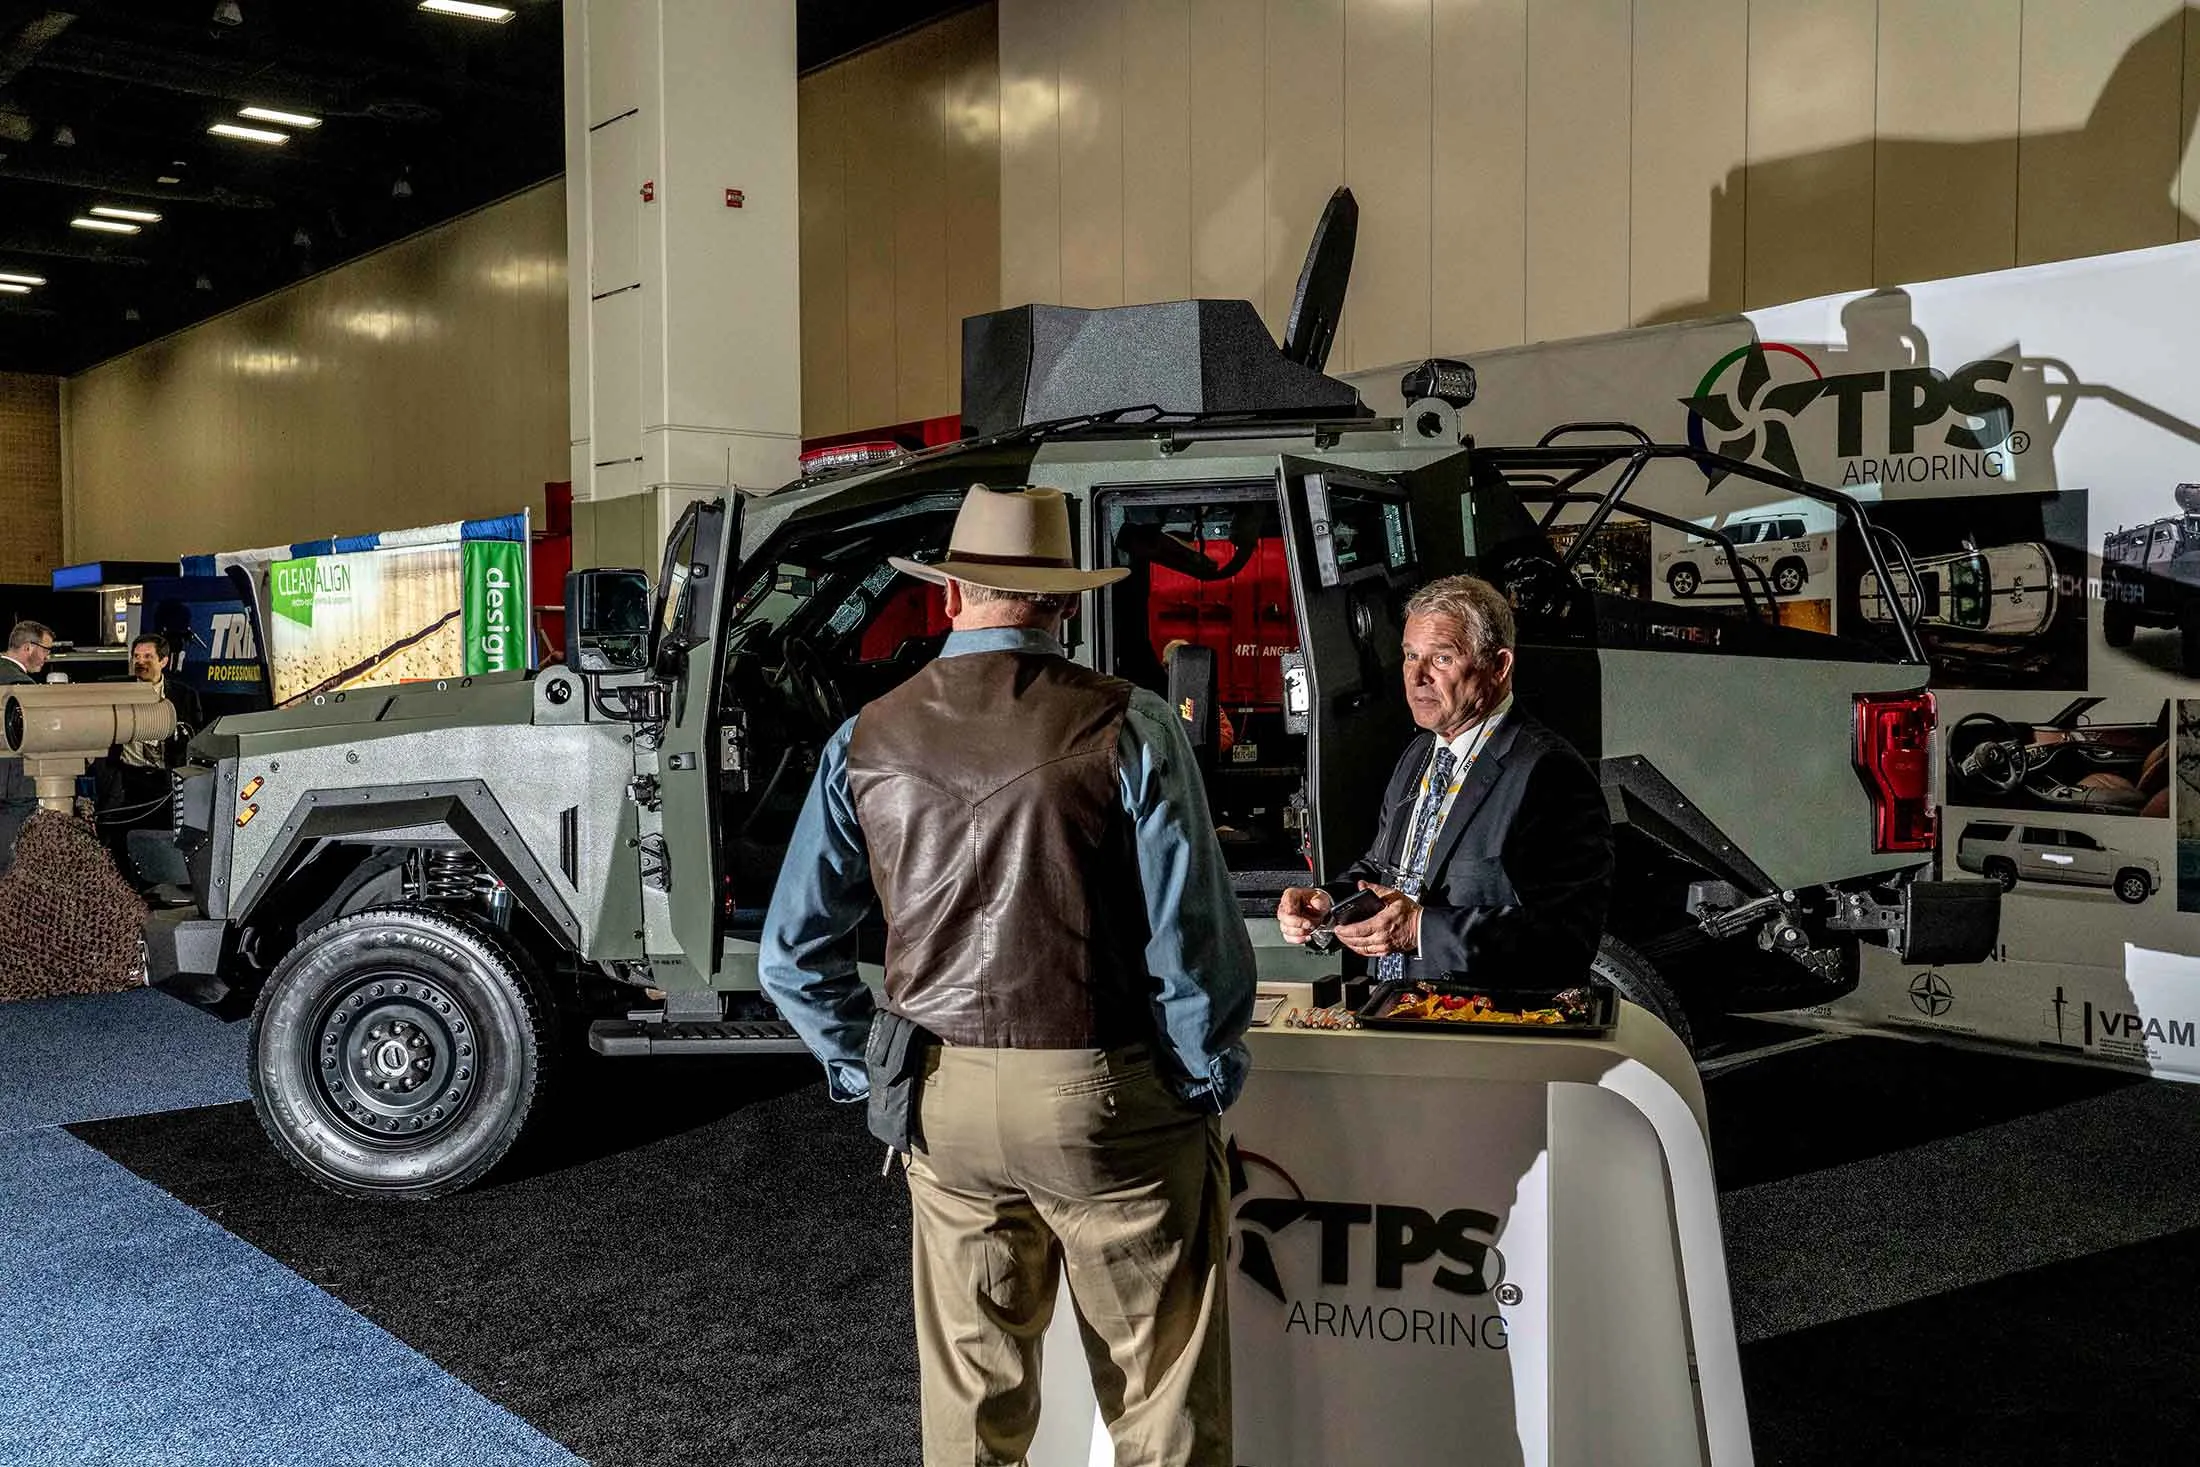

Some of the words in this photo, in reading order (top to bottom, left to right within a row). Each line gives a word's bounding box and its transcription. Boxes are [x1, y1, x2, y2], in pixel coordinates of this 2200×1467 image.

[1820, 360, 2014, 457] TPS
[1843, 451, 2004, 486] ARMORING
[278, 567, 313, 596] CLEAR
[315, 564, 351, 593] ALIGN
[482, 567, 511, 674] design
[411, 935, 459, 959] MULTI
[2098, 1010, 2196, 1048] VPAM
[1302, 1200, 1506, 1295] TPS
[1285, 1300, 1510, 1350] ARMORING
